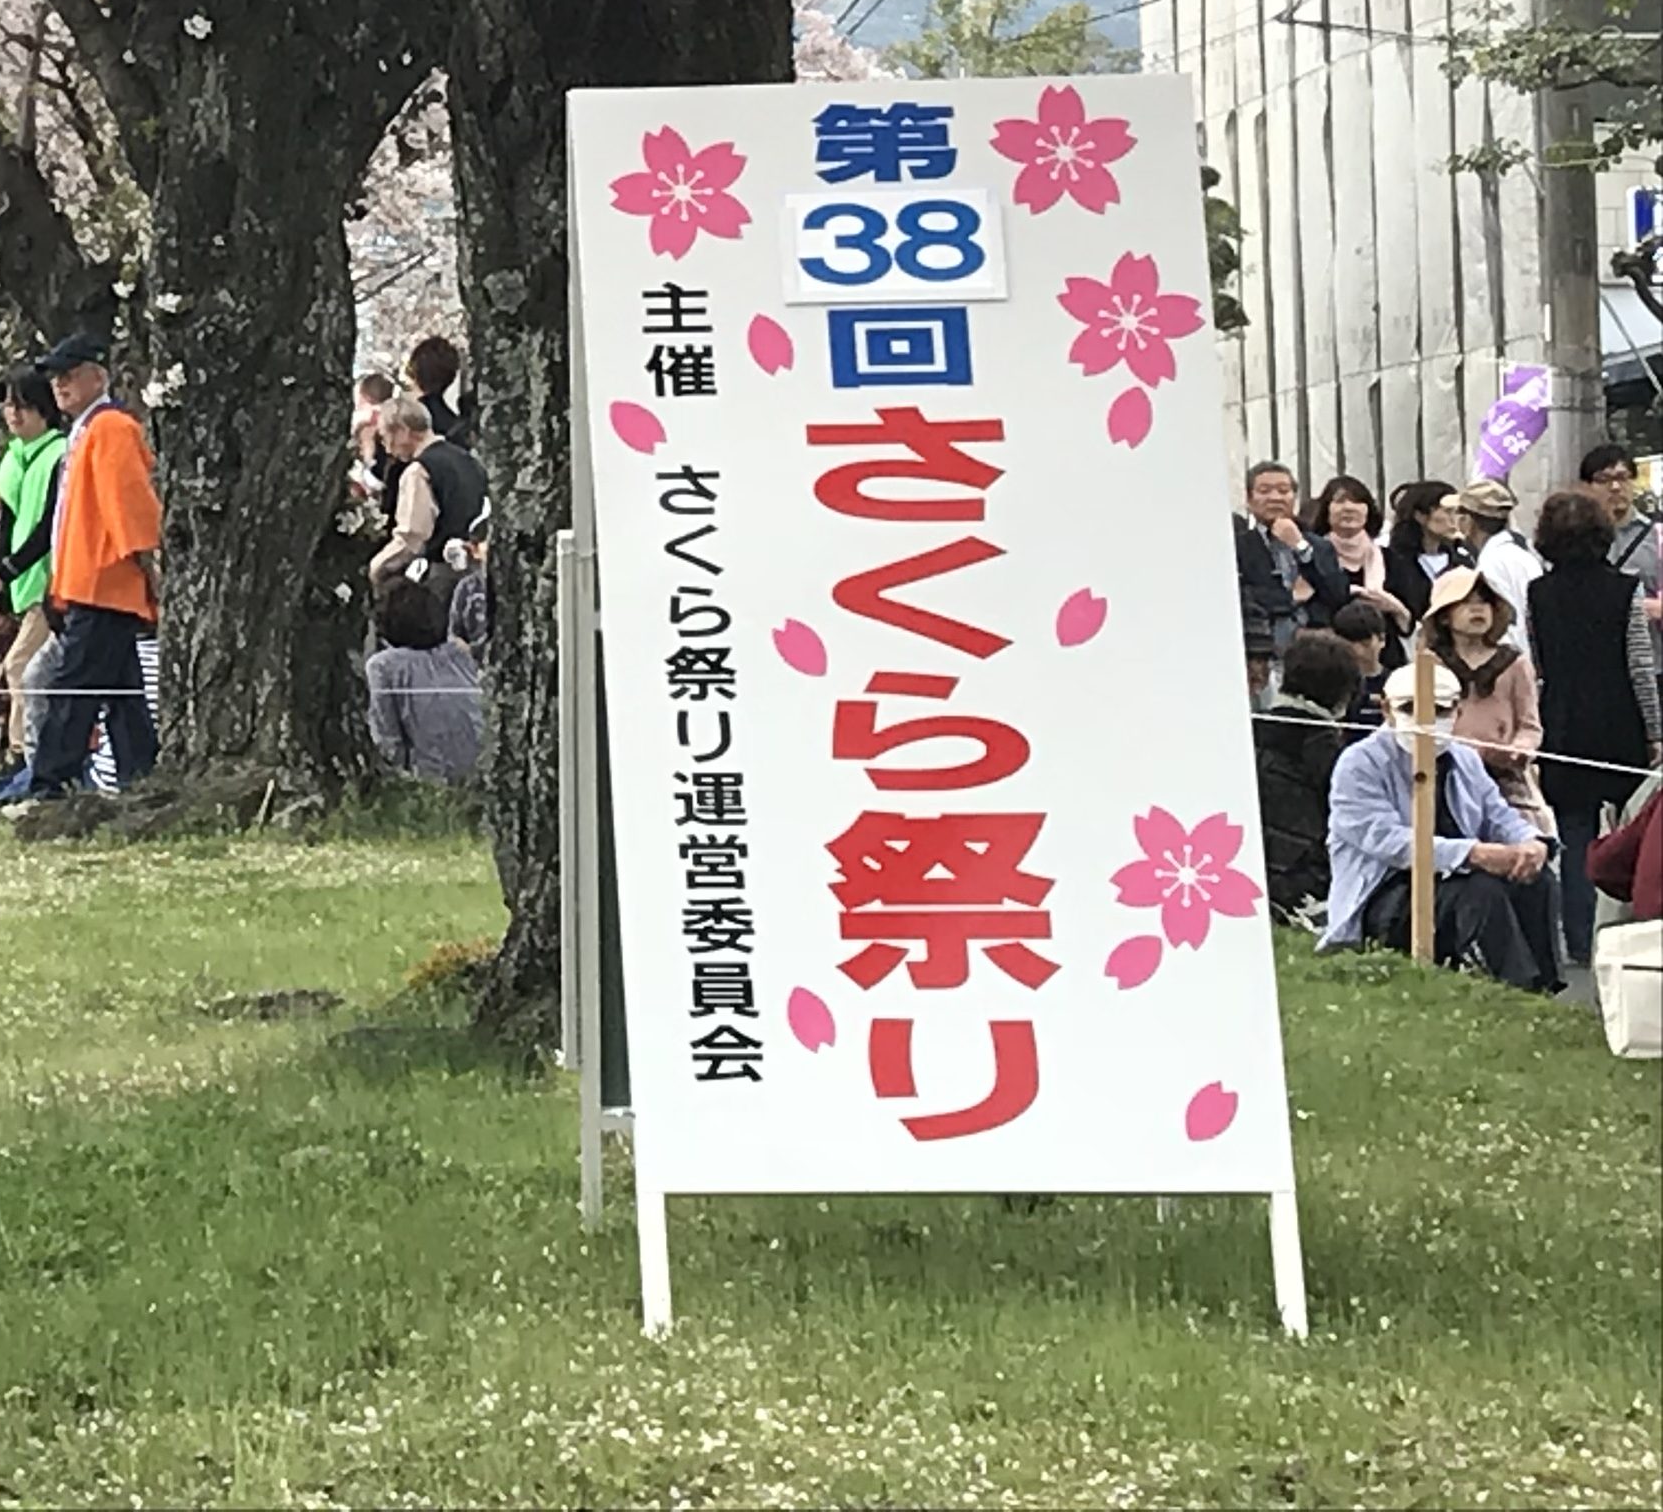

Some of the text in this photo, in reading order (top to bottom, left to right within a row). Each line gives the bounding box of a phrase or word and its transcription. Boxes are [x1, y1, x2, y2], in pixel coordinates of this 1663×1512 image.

[641, 281, 764, 1083] 主催 さくら祭り運営委員会
